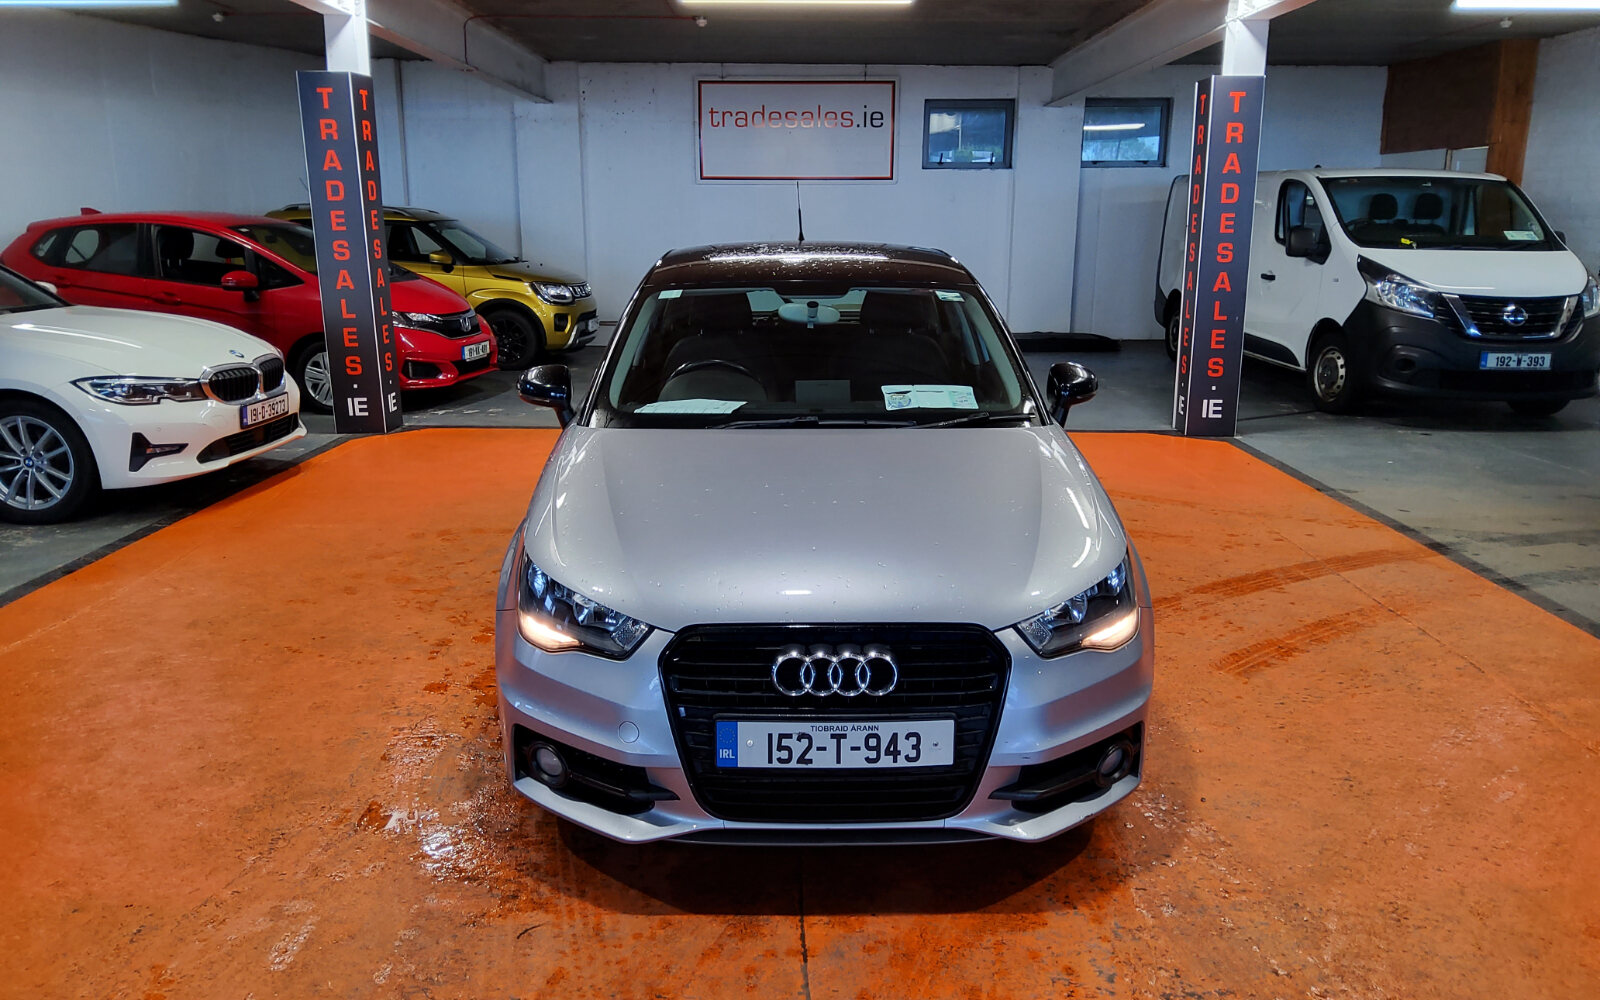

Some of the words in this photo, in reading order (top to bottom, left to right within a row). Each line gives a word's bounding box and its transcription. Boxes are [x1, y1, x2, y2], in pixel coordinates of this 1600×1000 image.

[708, 104, 884, 128] tradesales.ie
[850, 724, 879, 732] ÁRANN
[719, 748, 736, 759] IRL
[767, 731, 922, 765] 152-T-943
